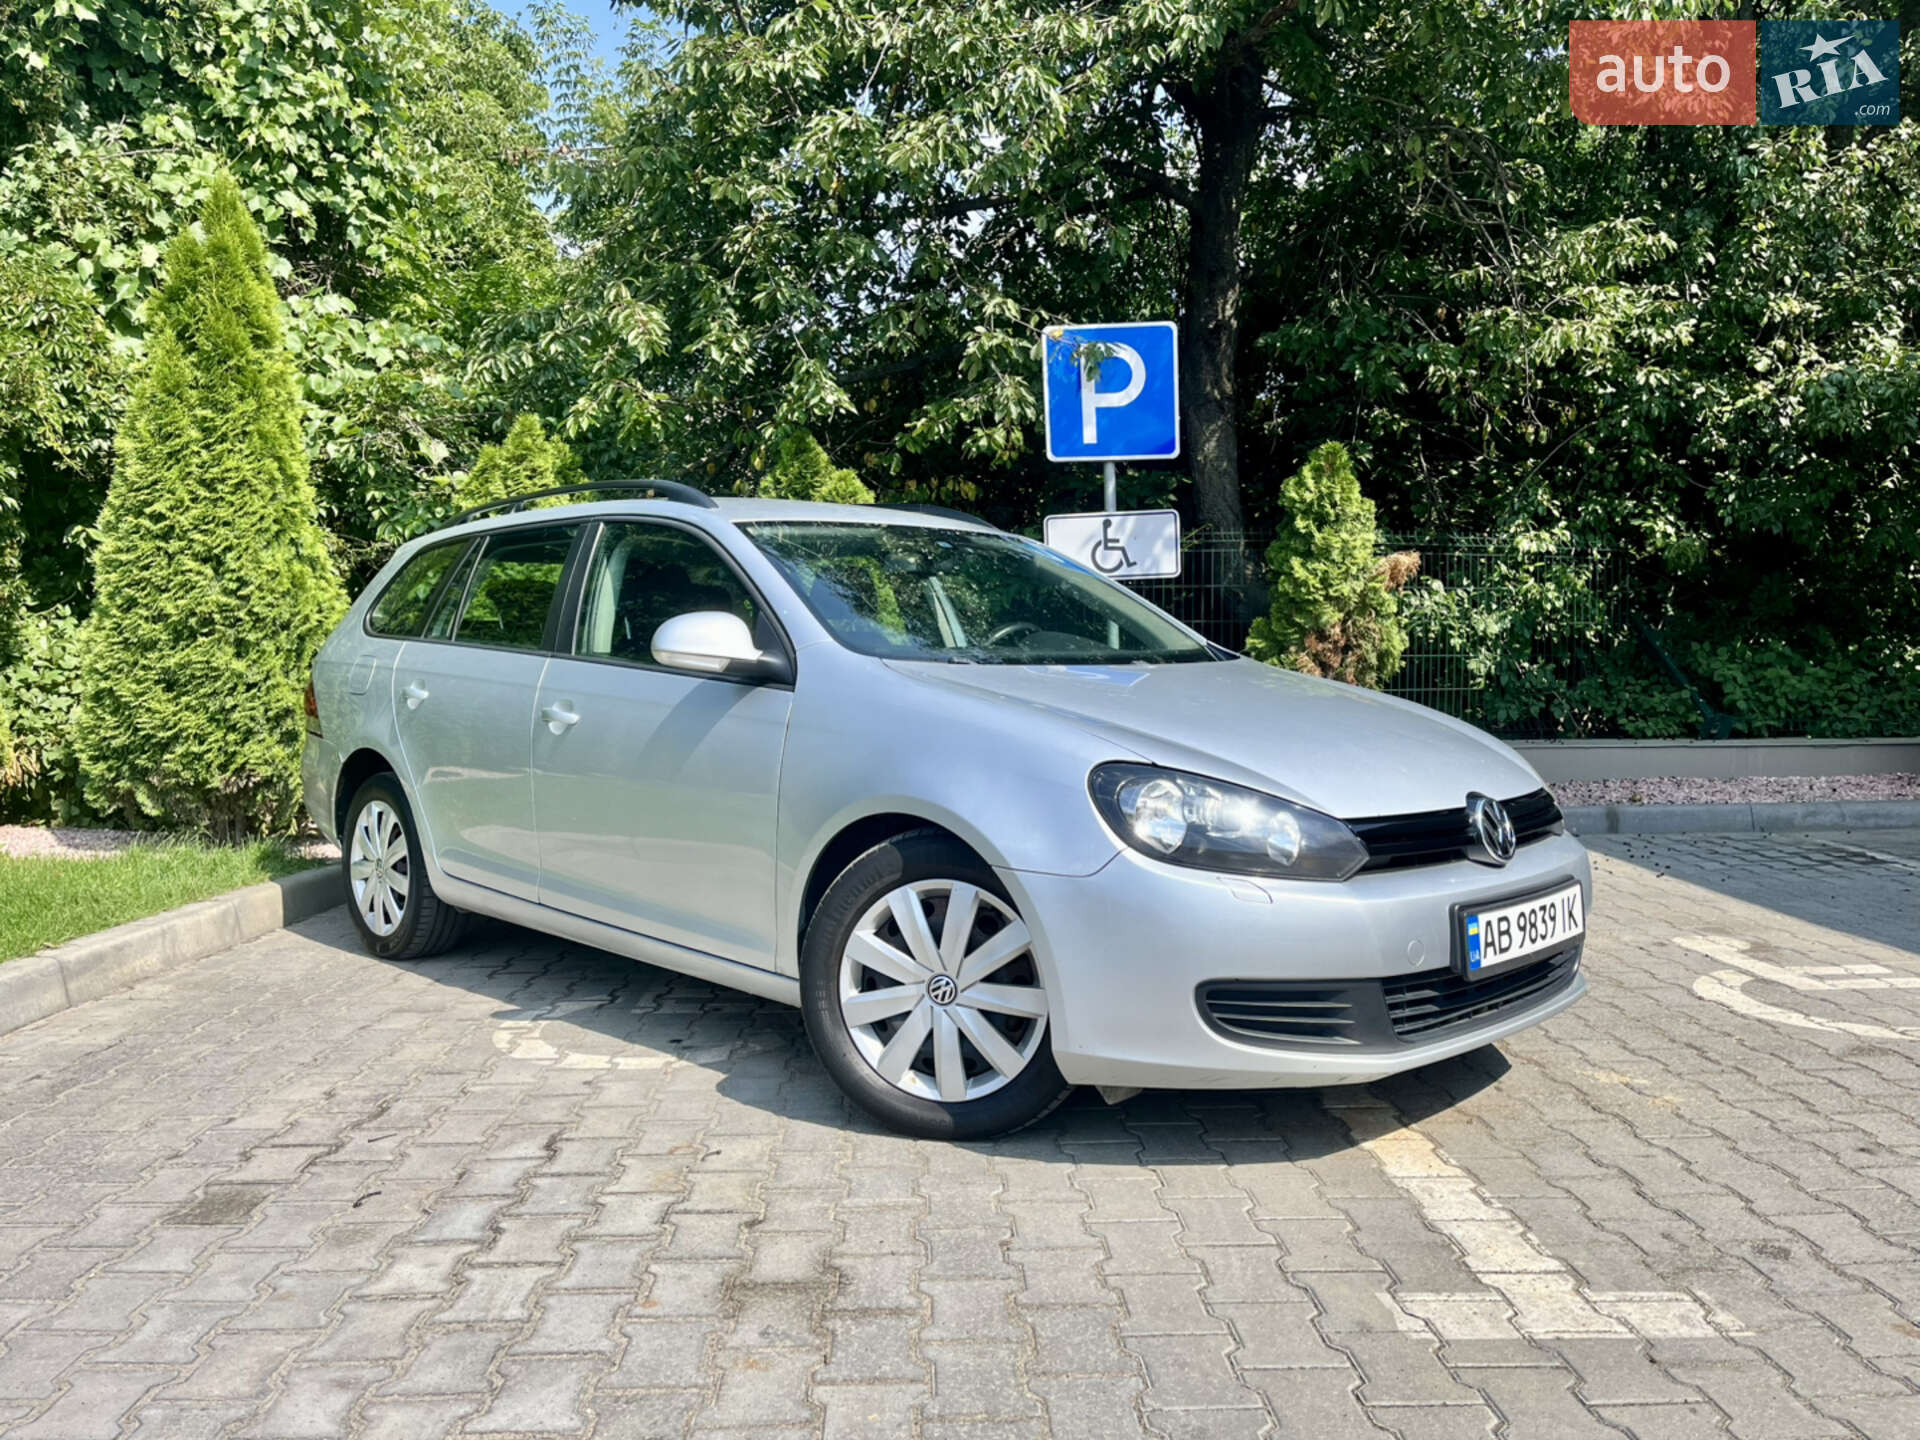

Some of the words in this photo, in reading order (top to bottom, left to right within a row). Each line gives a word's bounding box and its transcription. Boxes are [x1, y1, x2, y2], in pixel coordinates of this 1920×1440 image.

[1080, 341, 1146, 444] P
[1483, 915, 1513, 960] AB
[1516, 902, 1557, 950] 9839
[1561, 893, 1579, 935] IK
